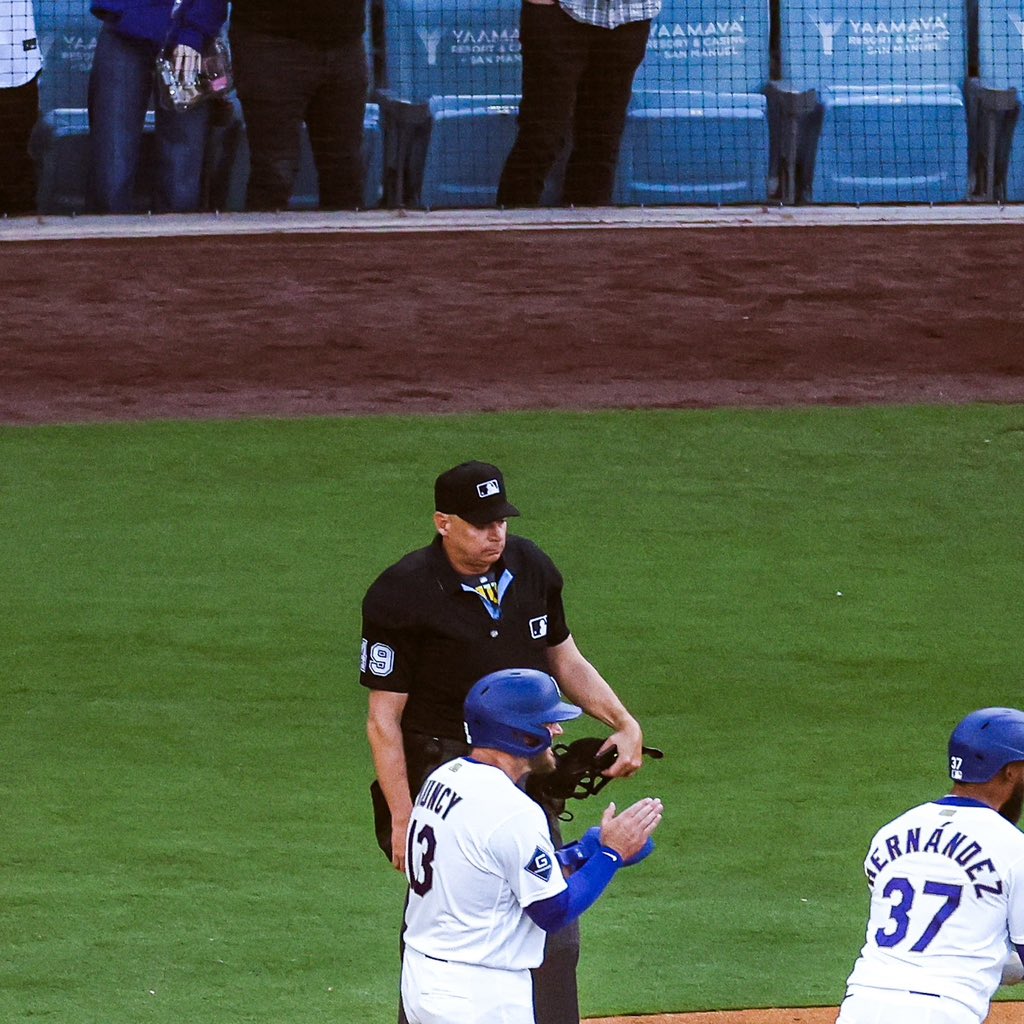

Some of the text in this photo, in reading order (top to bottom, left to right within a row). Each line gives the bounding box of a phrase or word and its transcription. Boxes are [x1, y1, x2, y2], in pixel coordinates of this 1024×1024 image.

[452, 28, 520, 43] YAAMA
[951, 756, 963, 770] 37
[416, 779, 463, 821] UNCY
[874, 876, 964, 953] 37
